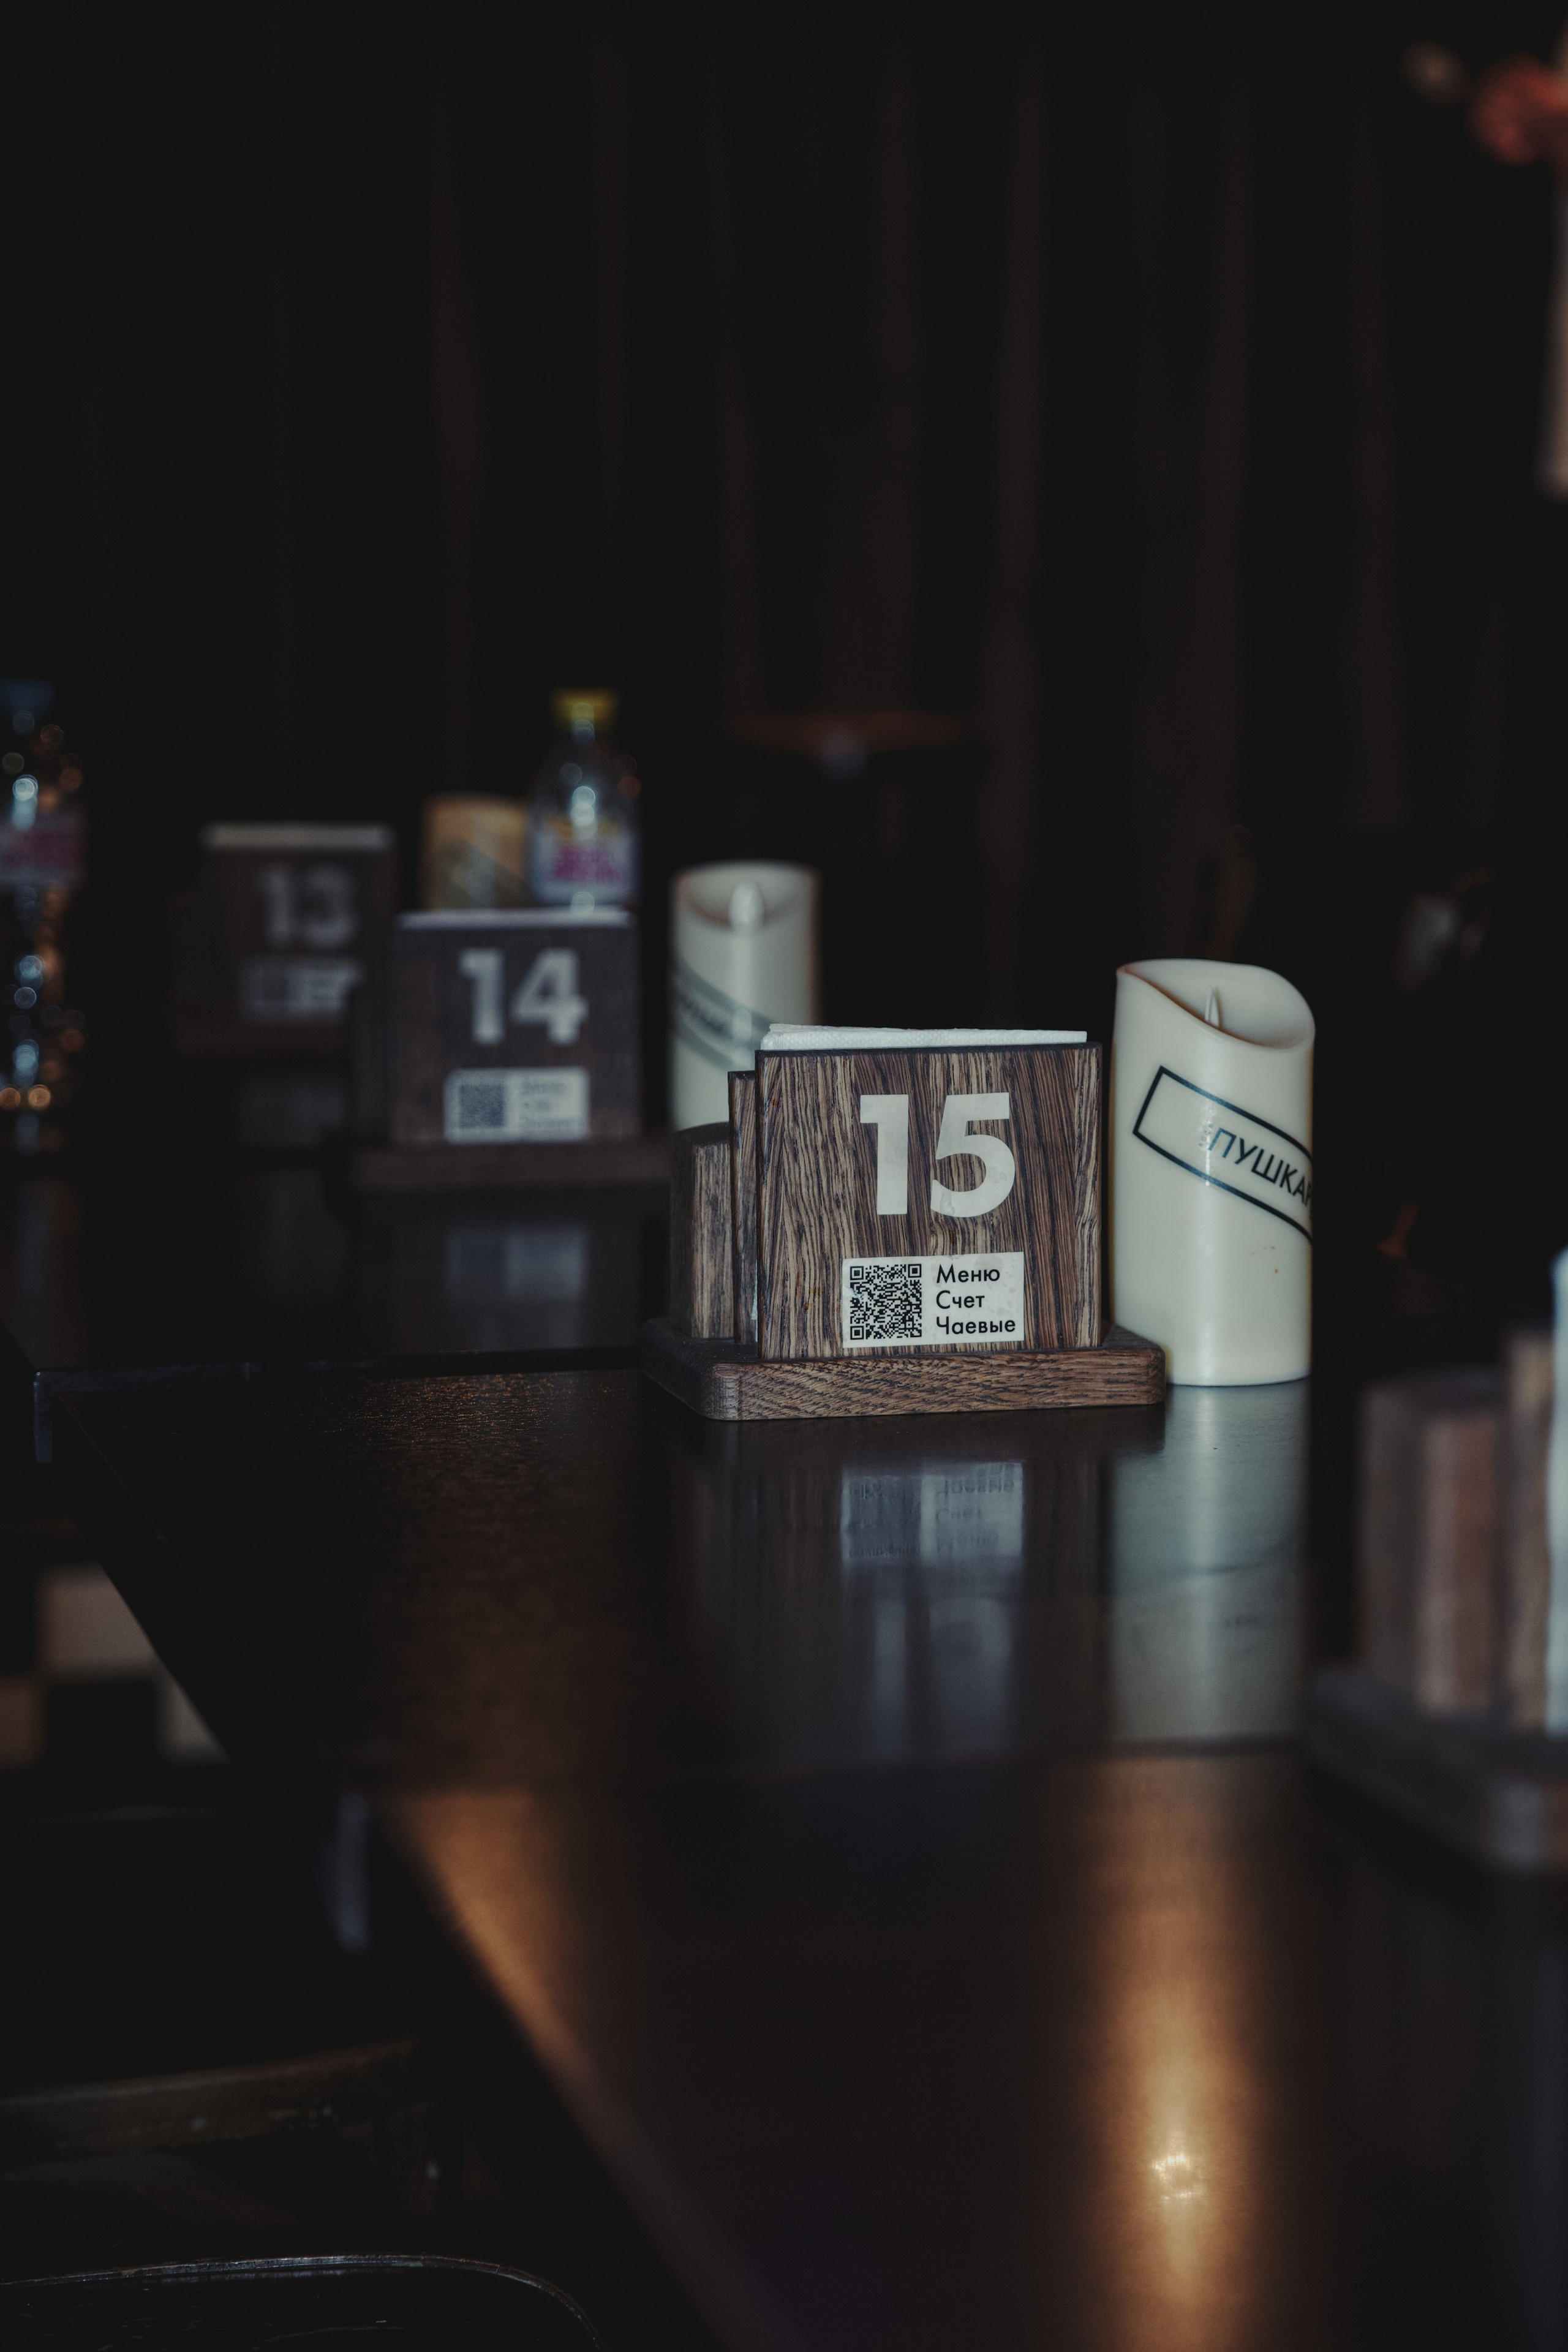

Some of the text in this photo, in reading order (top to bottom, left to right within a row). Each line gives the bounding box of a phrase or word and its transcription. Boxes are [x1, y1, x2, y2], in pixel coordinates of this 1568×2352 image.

[460, 948, 588, 1044] 14
[860, 1092, 1016, 1218] 15
[936, 1264, 1000, 1283] Меню
[936, 1290, 985, 1309] Счет
[936, 1316, 1016, 1335] Чаевые
